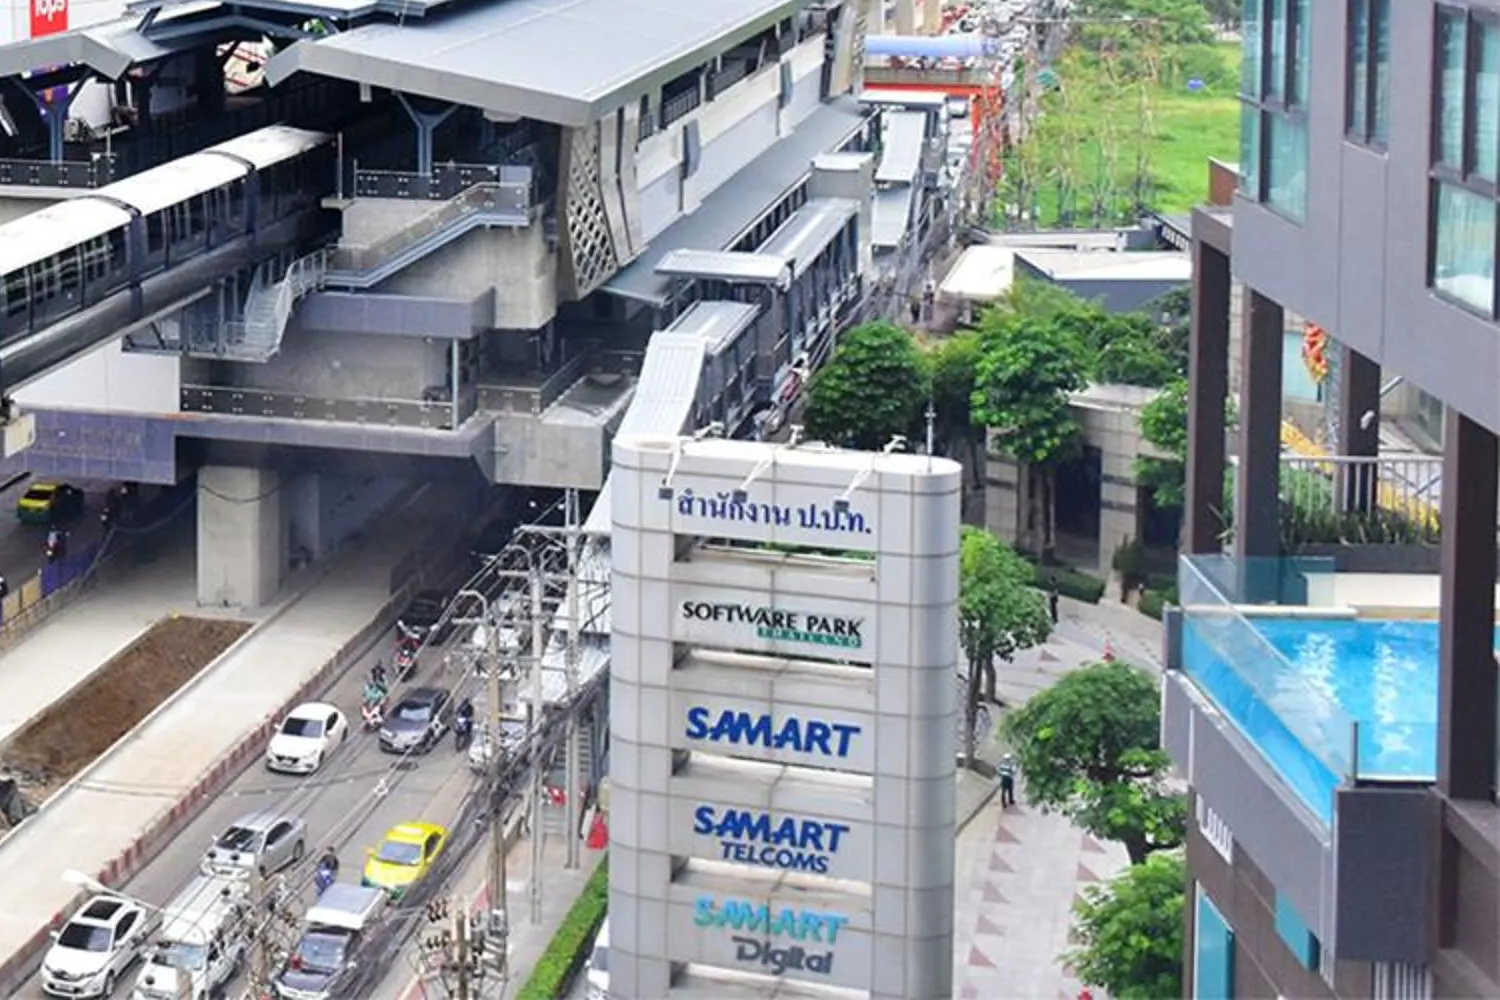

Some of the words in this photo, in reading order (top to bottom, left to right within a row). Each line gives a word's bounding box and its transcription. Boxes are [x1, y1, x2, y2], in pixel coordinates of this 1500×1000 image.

[678, 487, 791, 526] สำนักงาน
[682, 601, 798, 630] SOFTWARE
[806, 613, 865, 638] PARK
[686, 707, 861, 757] SAMART
[694, 806, 849, 852] SAMART
[720, 841, 831, 873] TELCOMS
[694, 894, 848, 944] SAMART
[731, 936, 834, 975] Digital
